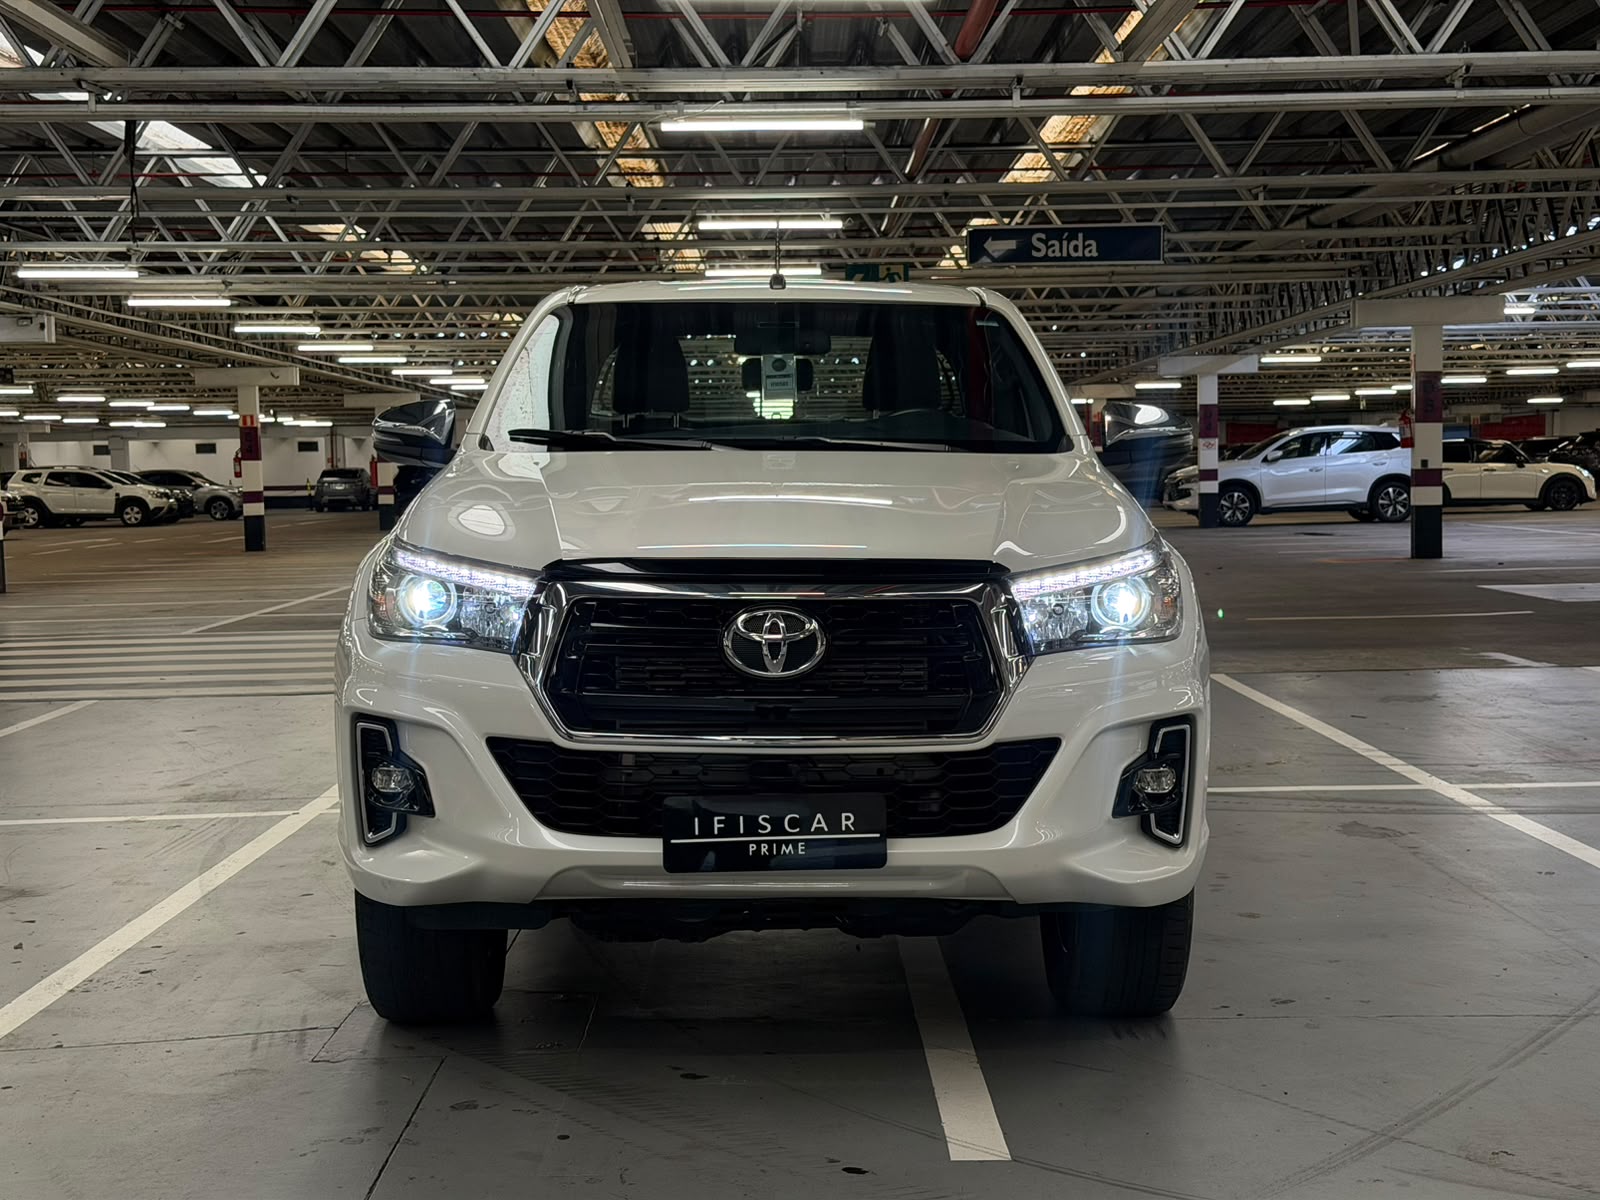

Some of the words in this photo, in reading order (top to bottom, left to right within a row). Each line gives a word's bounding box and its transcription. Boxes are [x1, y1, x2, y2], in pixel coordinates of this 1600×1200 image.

[1031, 232, 1099, 258] Saída
[694, 812, 855, 836] IFISCAR
[748, 841, 806, 856] PRIME
